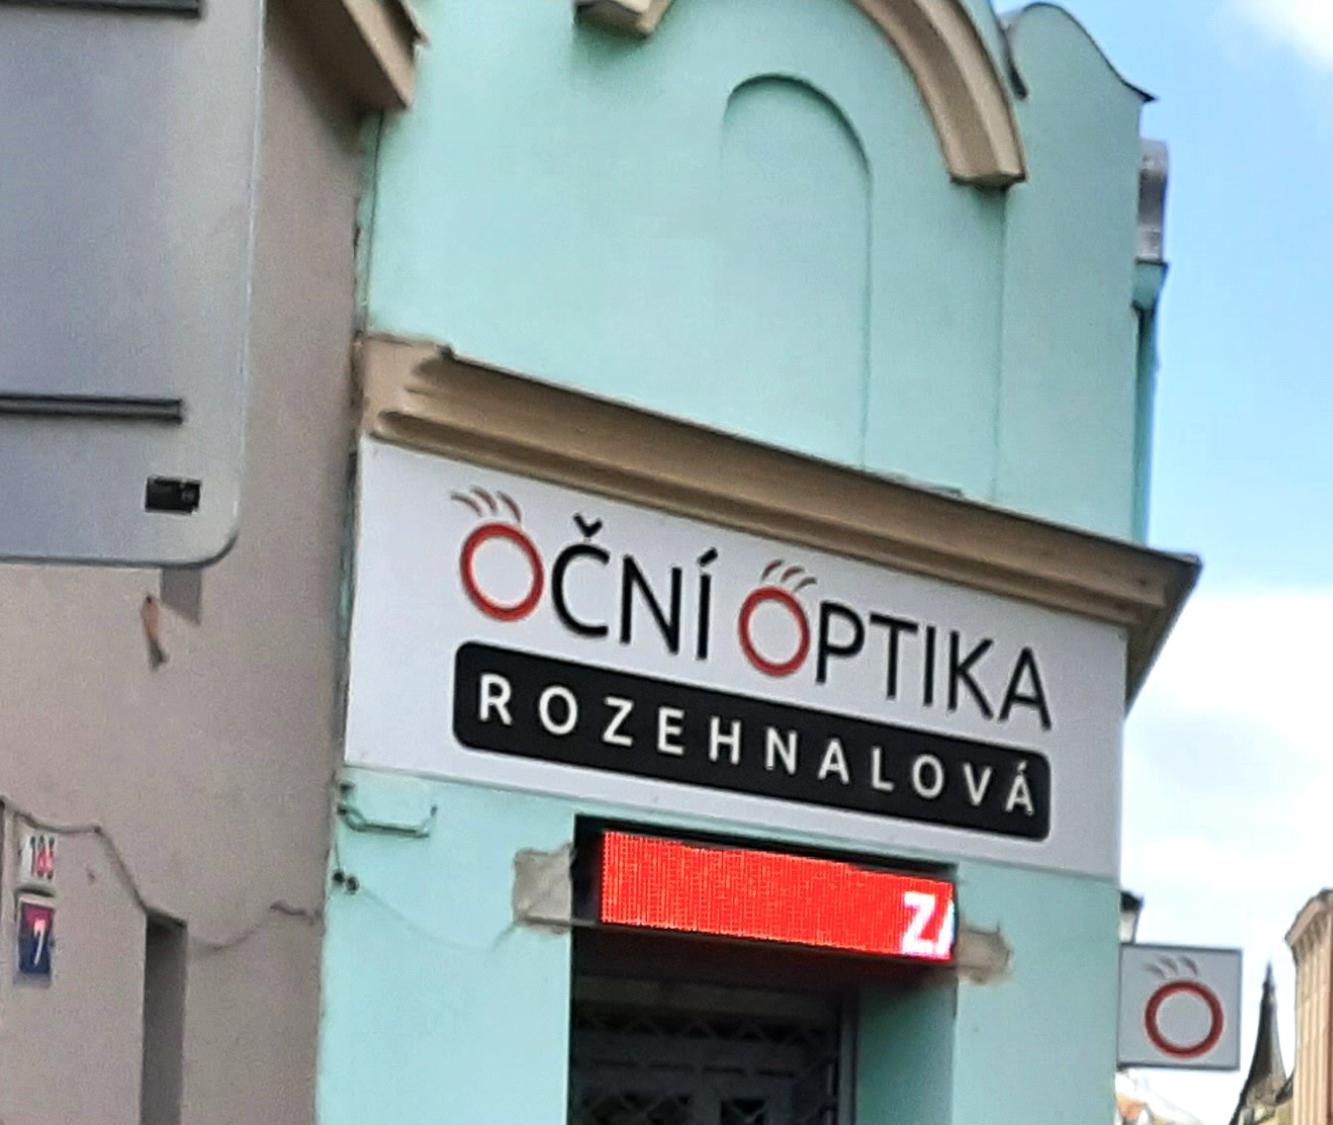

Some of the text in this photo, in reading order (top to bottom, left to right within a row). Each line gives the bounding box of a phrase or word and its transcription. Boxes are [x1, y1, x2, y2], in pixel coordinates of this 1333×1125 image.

[458, 512, 1052, 731] OČNÍ OPTIKA
[478, 672, 1035, 816] ROZEHNALOVÁ
[33, 918, 46, 966] 7
